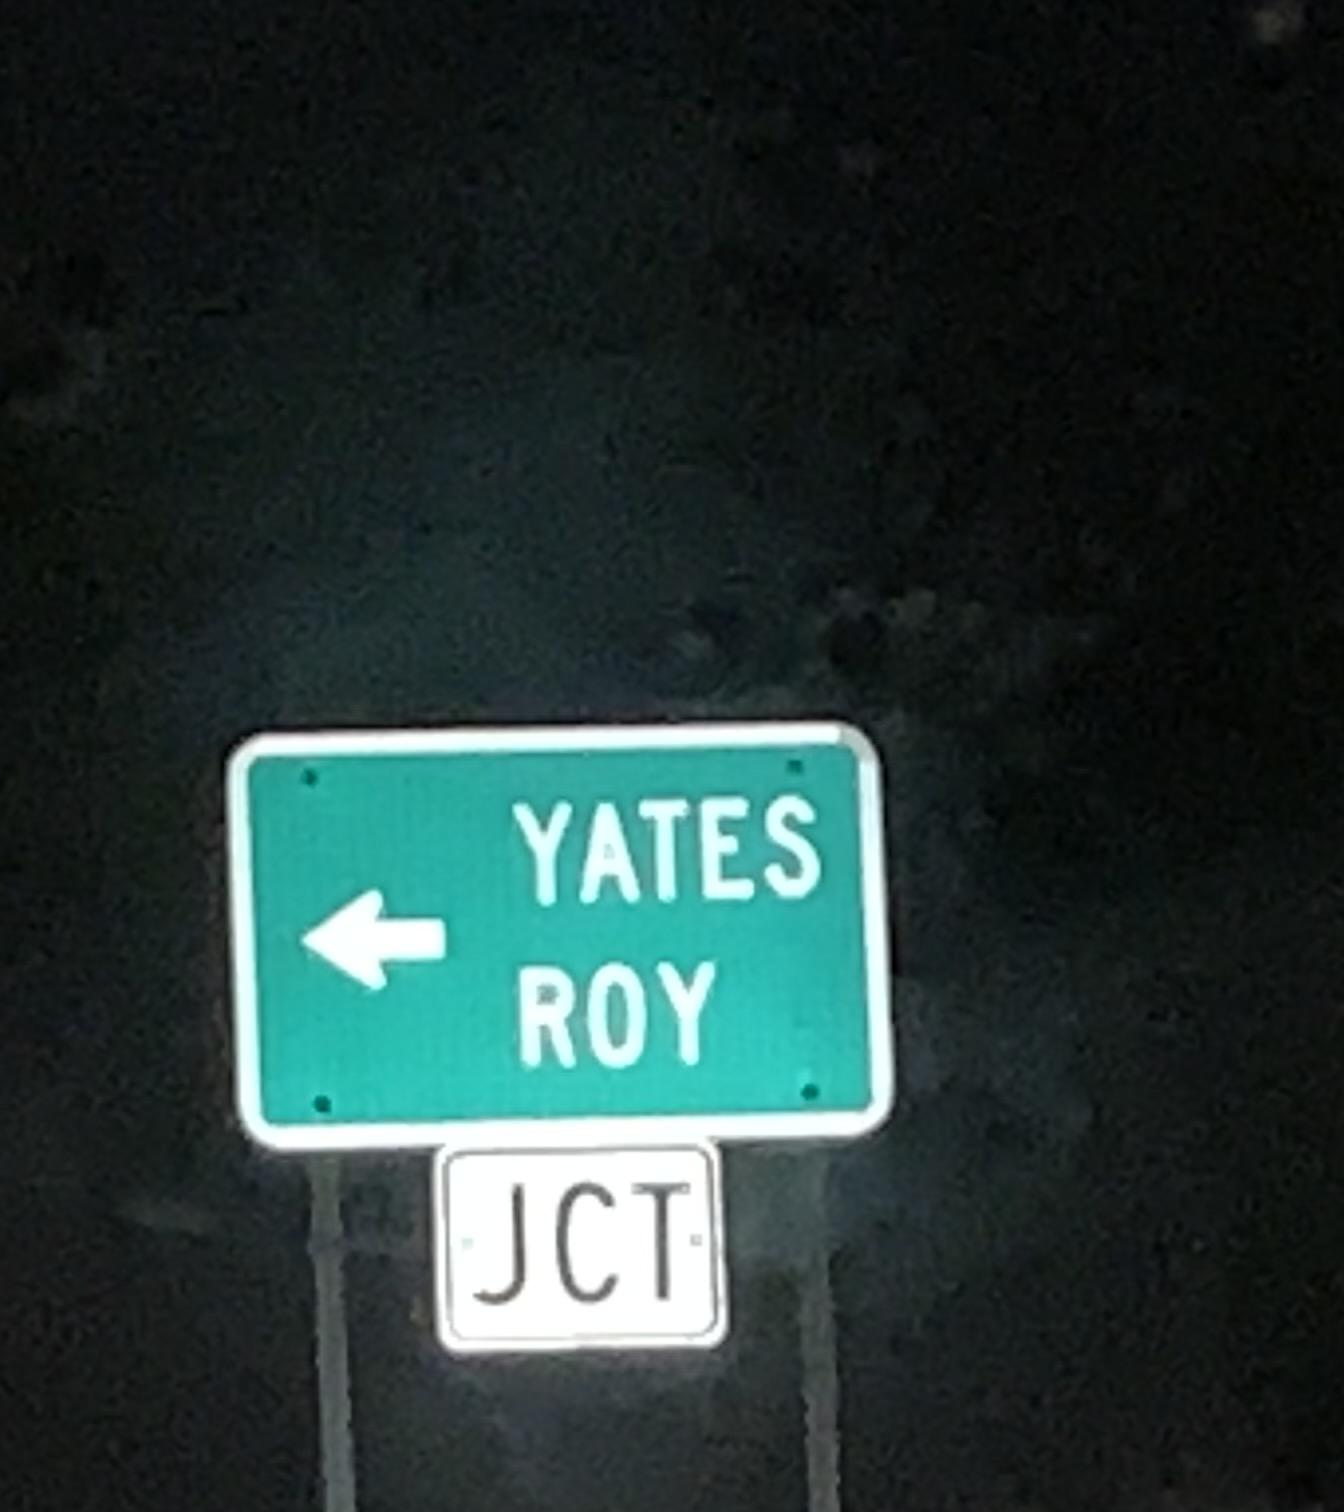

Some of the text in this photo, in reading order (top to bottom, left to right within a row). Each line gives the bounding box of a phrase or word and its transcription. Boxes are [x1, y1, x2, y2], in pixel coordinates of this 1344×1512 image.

[512, 795, 822, 905] YATES
[517, 961, 716, 1070] ROY
[471, 1181, 691, 1305] JCT
